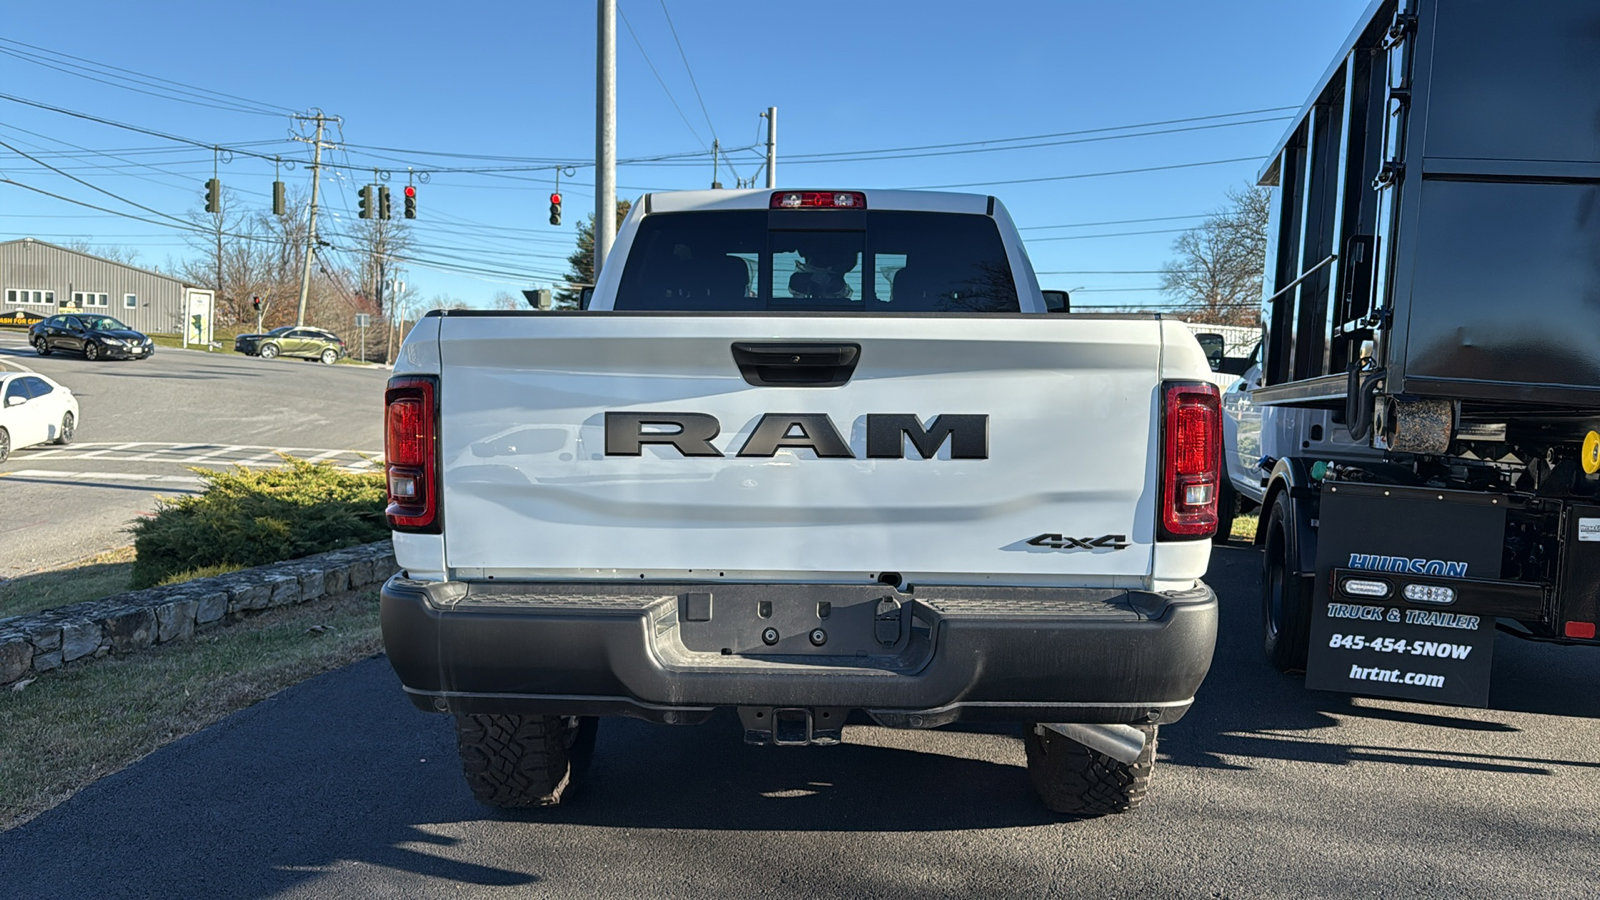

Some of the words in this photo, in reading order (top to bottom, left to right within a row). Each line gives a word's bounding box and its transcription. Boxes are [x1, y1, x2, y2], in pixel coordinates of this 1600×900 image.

[604, 411, 989, 459] RAM
[1026, 533, 1131, 550] 4x4
[1348, 553, 1468, 577] HUDSON
[1327, 603, 1384, 621] TRUCK
[1386, 608, 1400, 622] &
[1405, 609, 1480, 630] TRAILER
[1329, 633, 1472, 660] 845-454-SNOW
[1349, 664, 1446, 688] hrtnt.com
